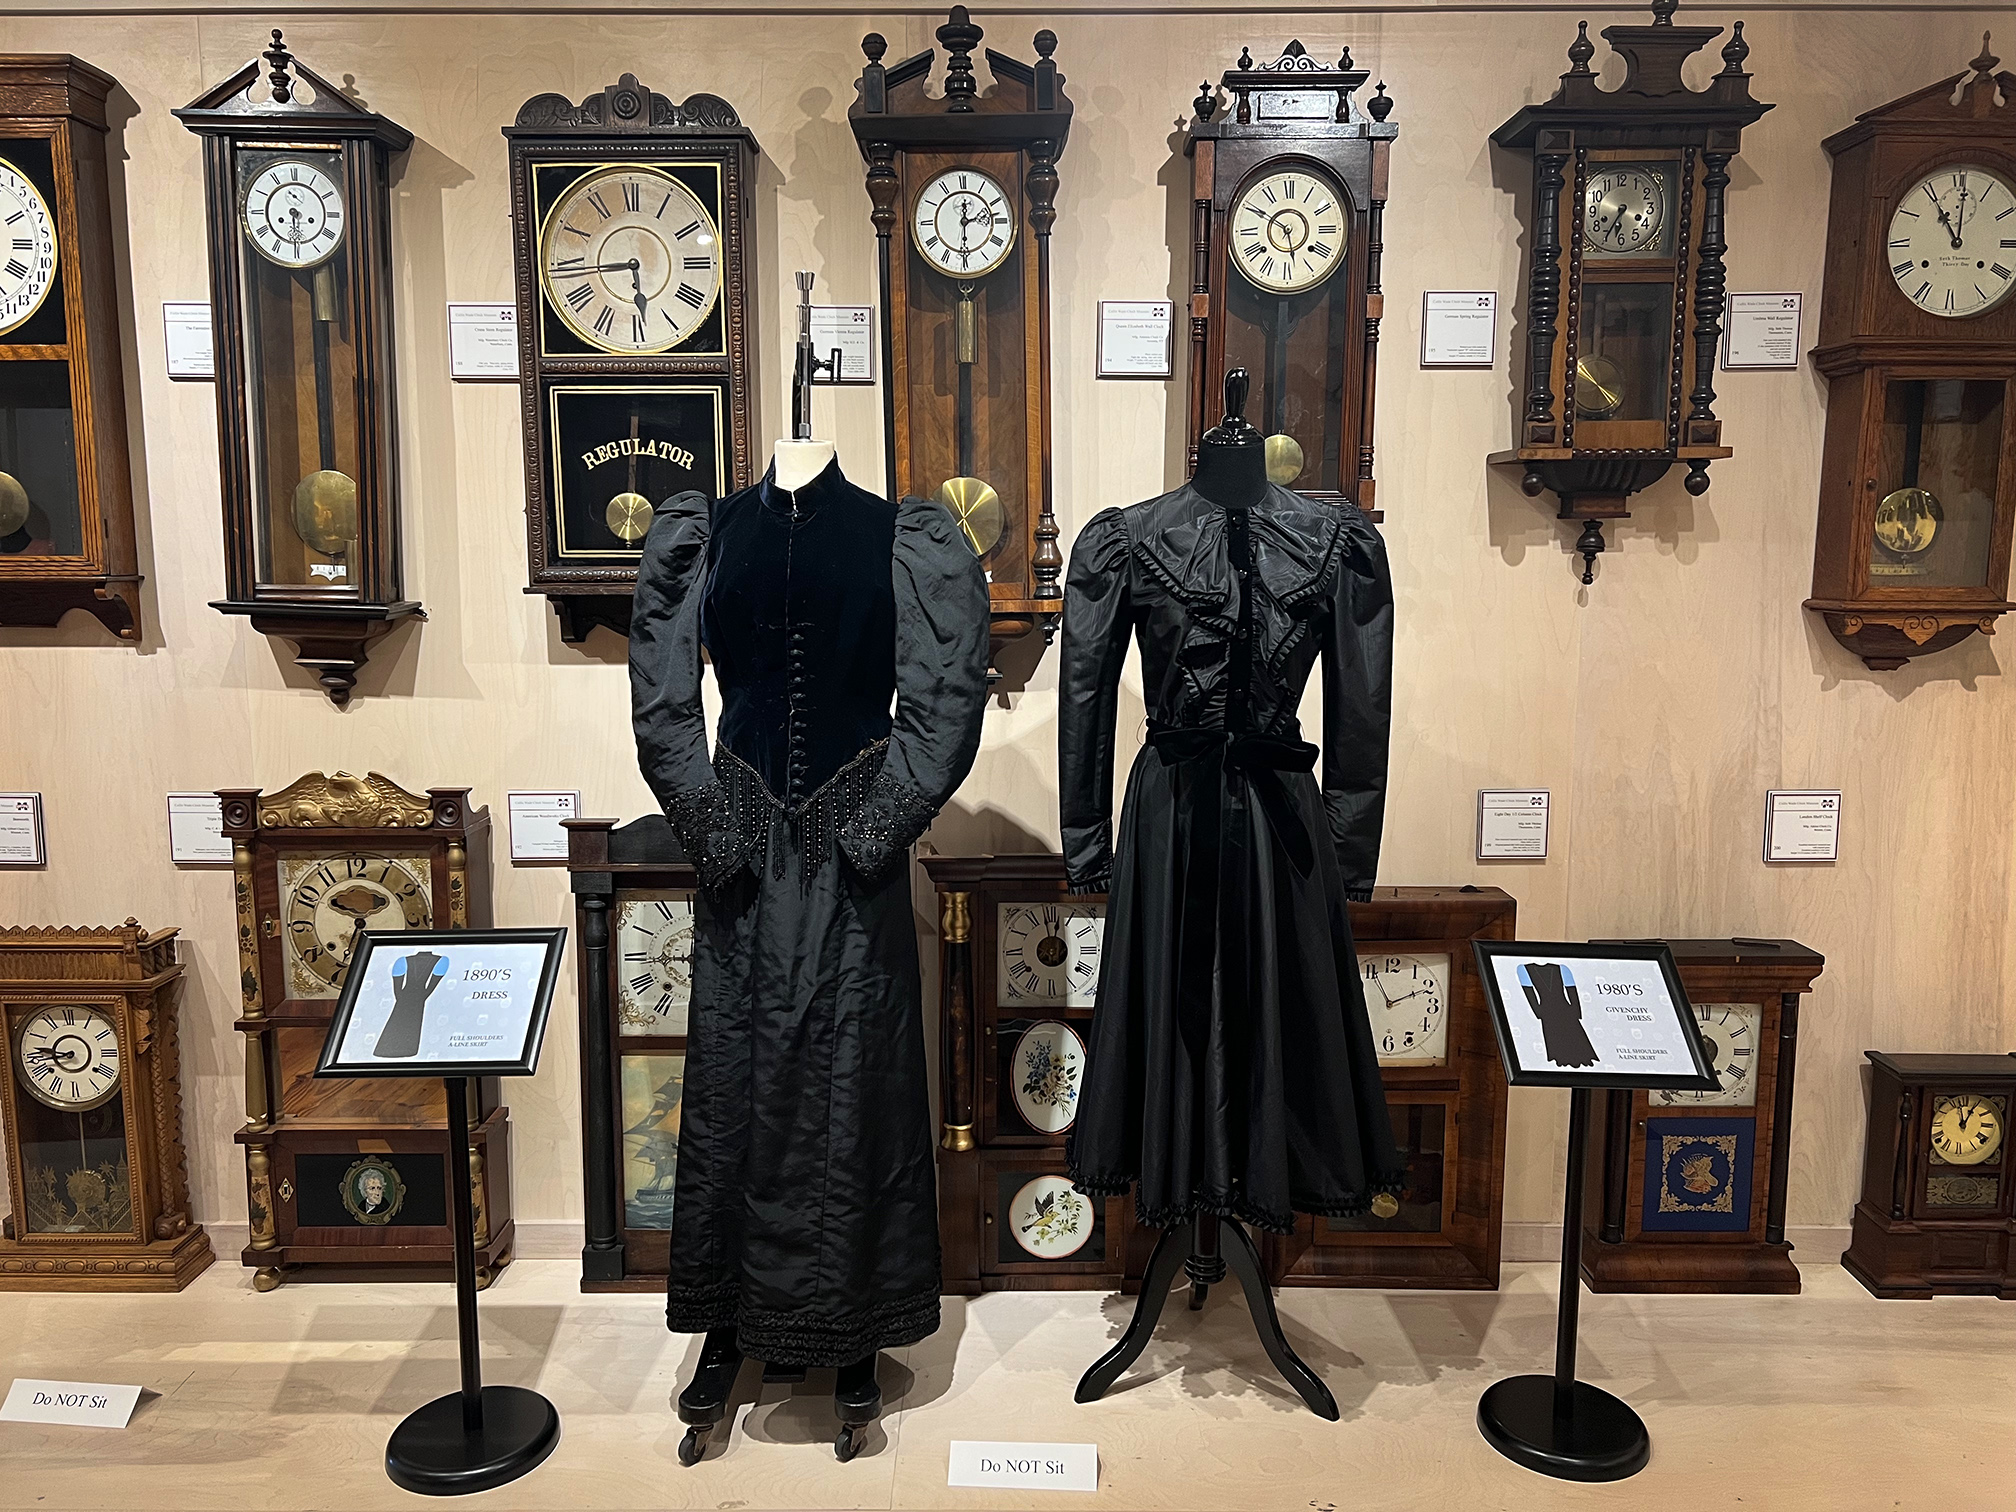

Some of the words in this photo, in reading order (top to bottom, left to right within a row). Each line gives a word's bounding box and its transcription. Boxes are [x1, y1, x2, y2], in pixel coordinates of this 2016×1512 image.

[1603, 179, 1611, 192] 11
[1616, 174, 1627, 187] 12
[1634, 178, 1637, 190] 1
[20, 186, 26, 197] 5
[621, 183, 642, 213] XII
[1592, 190, 1602, 203] 10
[1643, 187, 1651, 200] 2
[1980, 181, 1995, 202] I
[29, 198, 37, 209] 6
[656, 193, 671, 220] I
[1646, 202, 1654, 214] 3
[38, 212, 45, 223] 7
[1589, 206, 1596, 218] 9
[1995, 207, 2016, 222] II
[1593, 220, 1600, 232] 8
[1641, 218, 1649, 229] 4
[41, 227, 49, 238] 8
[674, 220, 701, 241] II
[1631, 229, 1639, 241] 5
[1618, 233, 1625, 245] 6
[44, 242, 51, 253] 9
[41, 257, 52, 269] 10
[683, 256, 711, 269] III
[37, 271, 46, 282] 11
[29, 284, 39, 295] 12
[1913, 281, 1933, 303] VII
[19, 295, 30, 306] 13
[566, 283, 596, 313] VIII
[593, 305, 616, 336] VII
[660, 308, 680, 333] V
[632, 315, 647, 342] VI
[582, 438, 695, 470] REGULATOR
[347, 858, 370, 878] 12
[380, 865, 391, 884] 1
[318, 866, 337, 887] 11
[297, 885, 320, 909] 10
[395, 883, 416, 903] 2
[293, 920, 314, 933] 9
[1075, 926, 1092, 938] II
[304, 946, 324, 963] 8
[1366, 964, 1376, 979] 11
[1385, 958, 1401, 973] 12
[1412, 965, 1417, 979] 1
[331, 963, 348, 983] 7
[463, 969, 512, 981] 1890'S
[1423, 979, 1434, 995] 2
[1596, 983, 1644, 996] 1980'S
[472, 991, 508, 1000] DRESS
[1427, 998, 1439, 1014] 3
[1418, 1017, 1430, 1032] 4
[95, 1029, 111, 1041] II
[1403, 1032, 1414, 1047] 5
[1383, 1035, 1394, 1052] 6
[101, 1049, 117, 1057] III
[33, 1392, 52, 1405] Do
[54, 1394, 88, 1408] NOT
[89, 1395, 108, 1408] Sit
[981, 1459, 1001, 1473] Do
[1006, 1460, 1041, 1474] NOT
[1046, 1461, 1064, 1475] Sit
